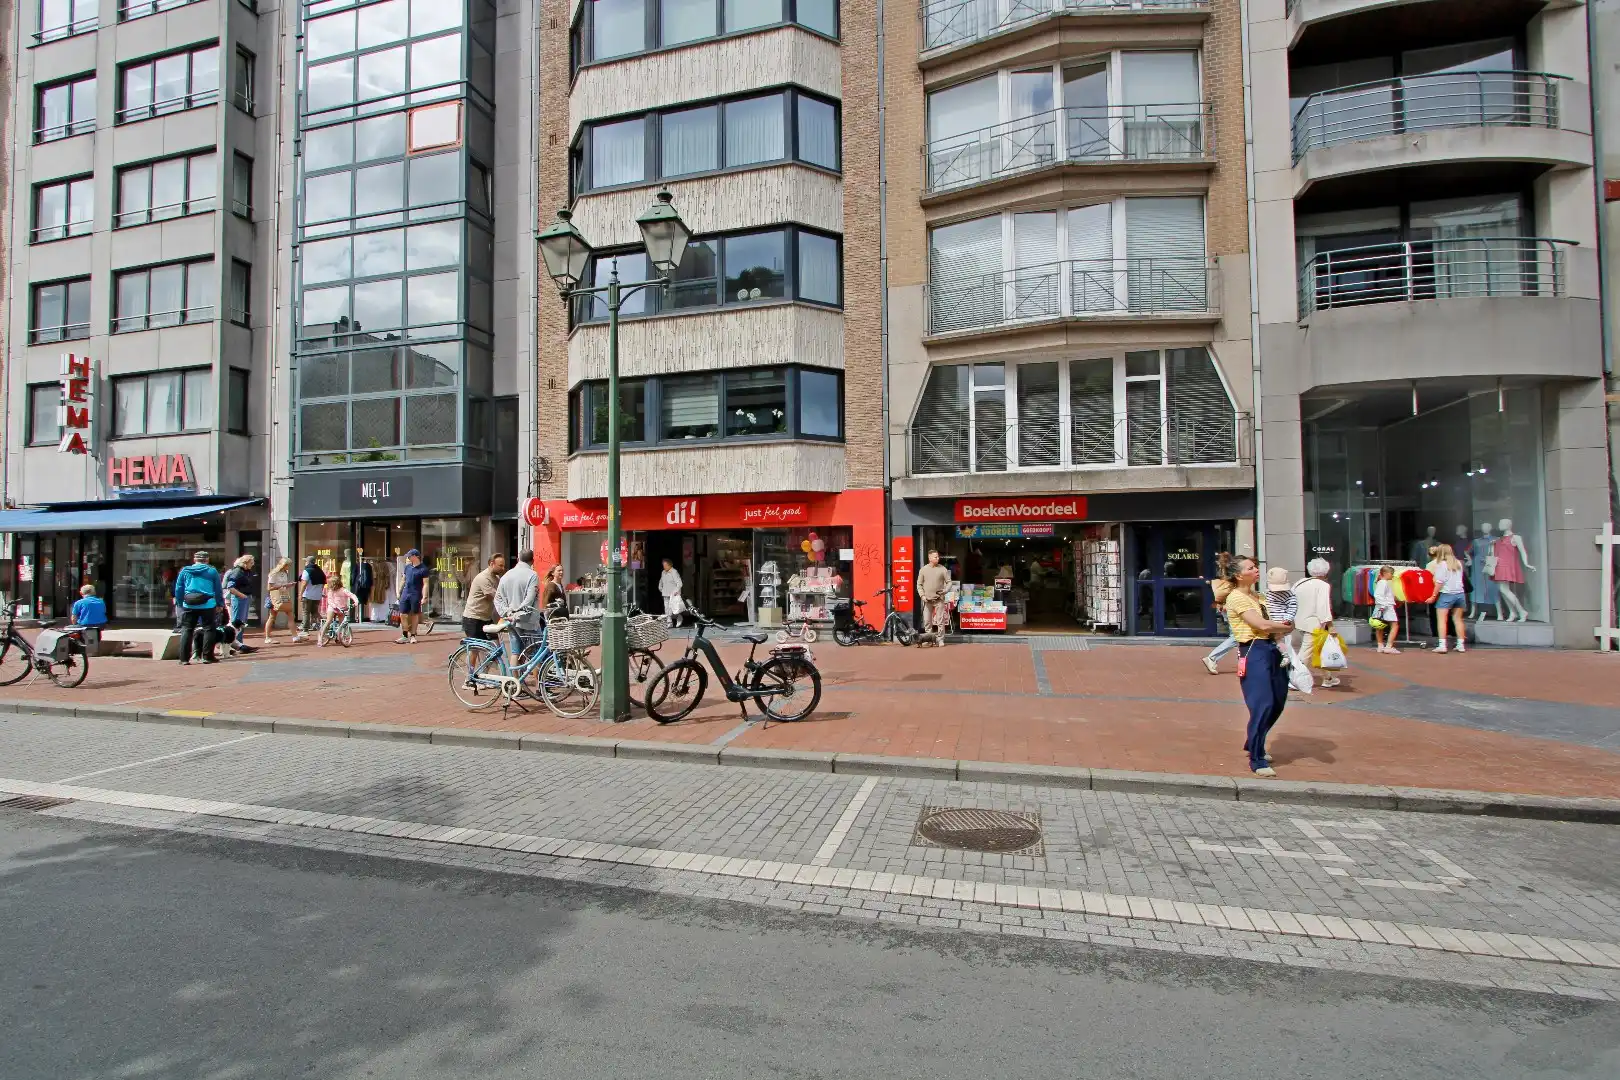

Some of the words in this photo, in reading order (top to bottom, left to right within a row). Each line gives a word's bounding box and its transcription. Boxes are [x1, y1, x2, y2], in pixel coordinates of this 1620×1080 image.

[62, 353, 90, 455] HEMA
[108, 453, 192, 486] HEMA
[361, 481, 390, 498] MEI-LI
[530, 504, 544, 519] di!
[666, 500, 697, 525] di!
[743, 508, 762, 521] just
[762, 505, 780, 520] feel
[779, 505, 802, 520] good
[963, 501, 1078, 518] BoekenVoordeel
[562, 513, 579, 525] just
[580, 511, 594, 525] feel
[592, 513, 609, 525] goo
[980, 527, 1019, 536] VOORDEEL
[1167, 552, 1200, 560] SOLARIS
[436, 557, 464, 572] MEI-LI
